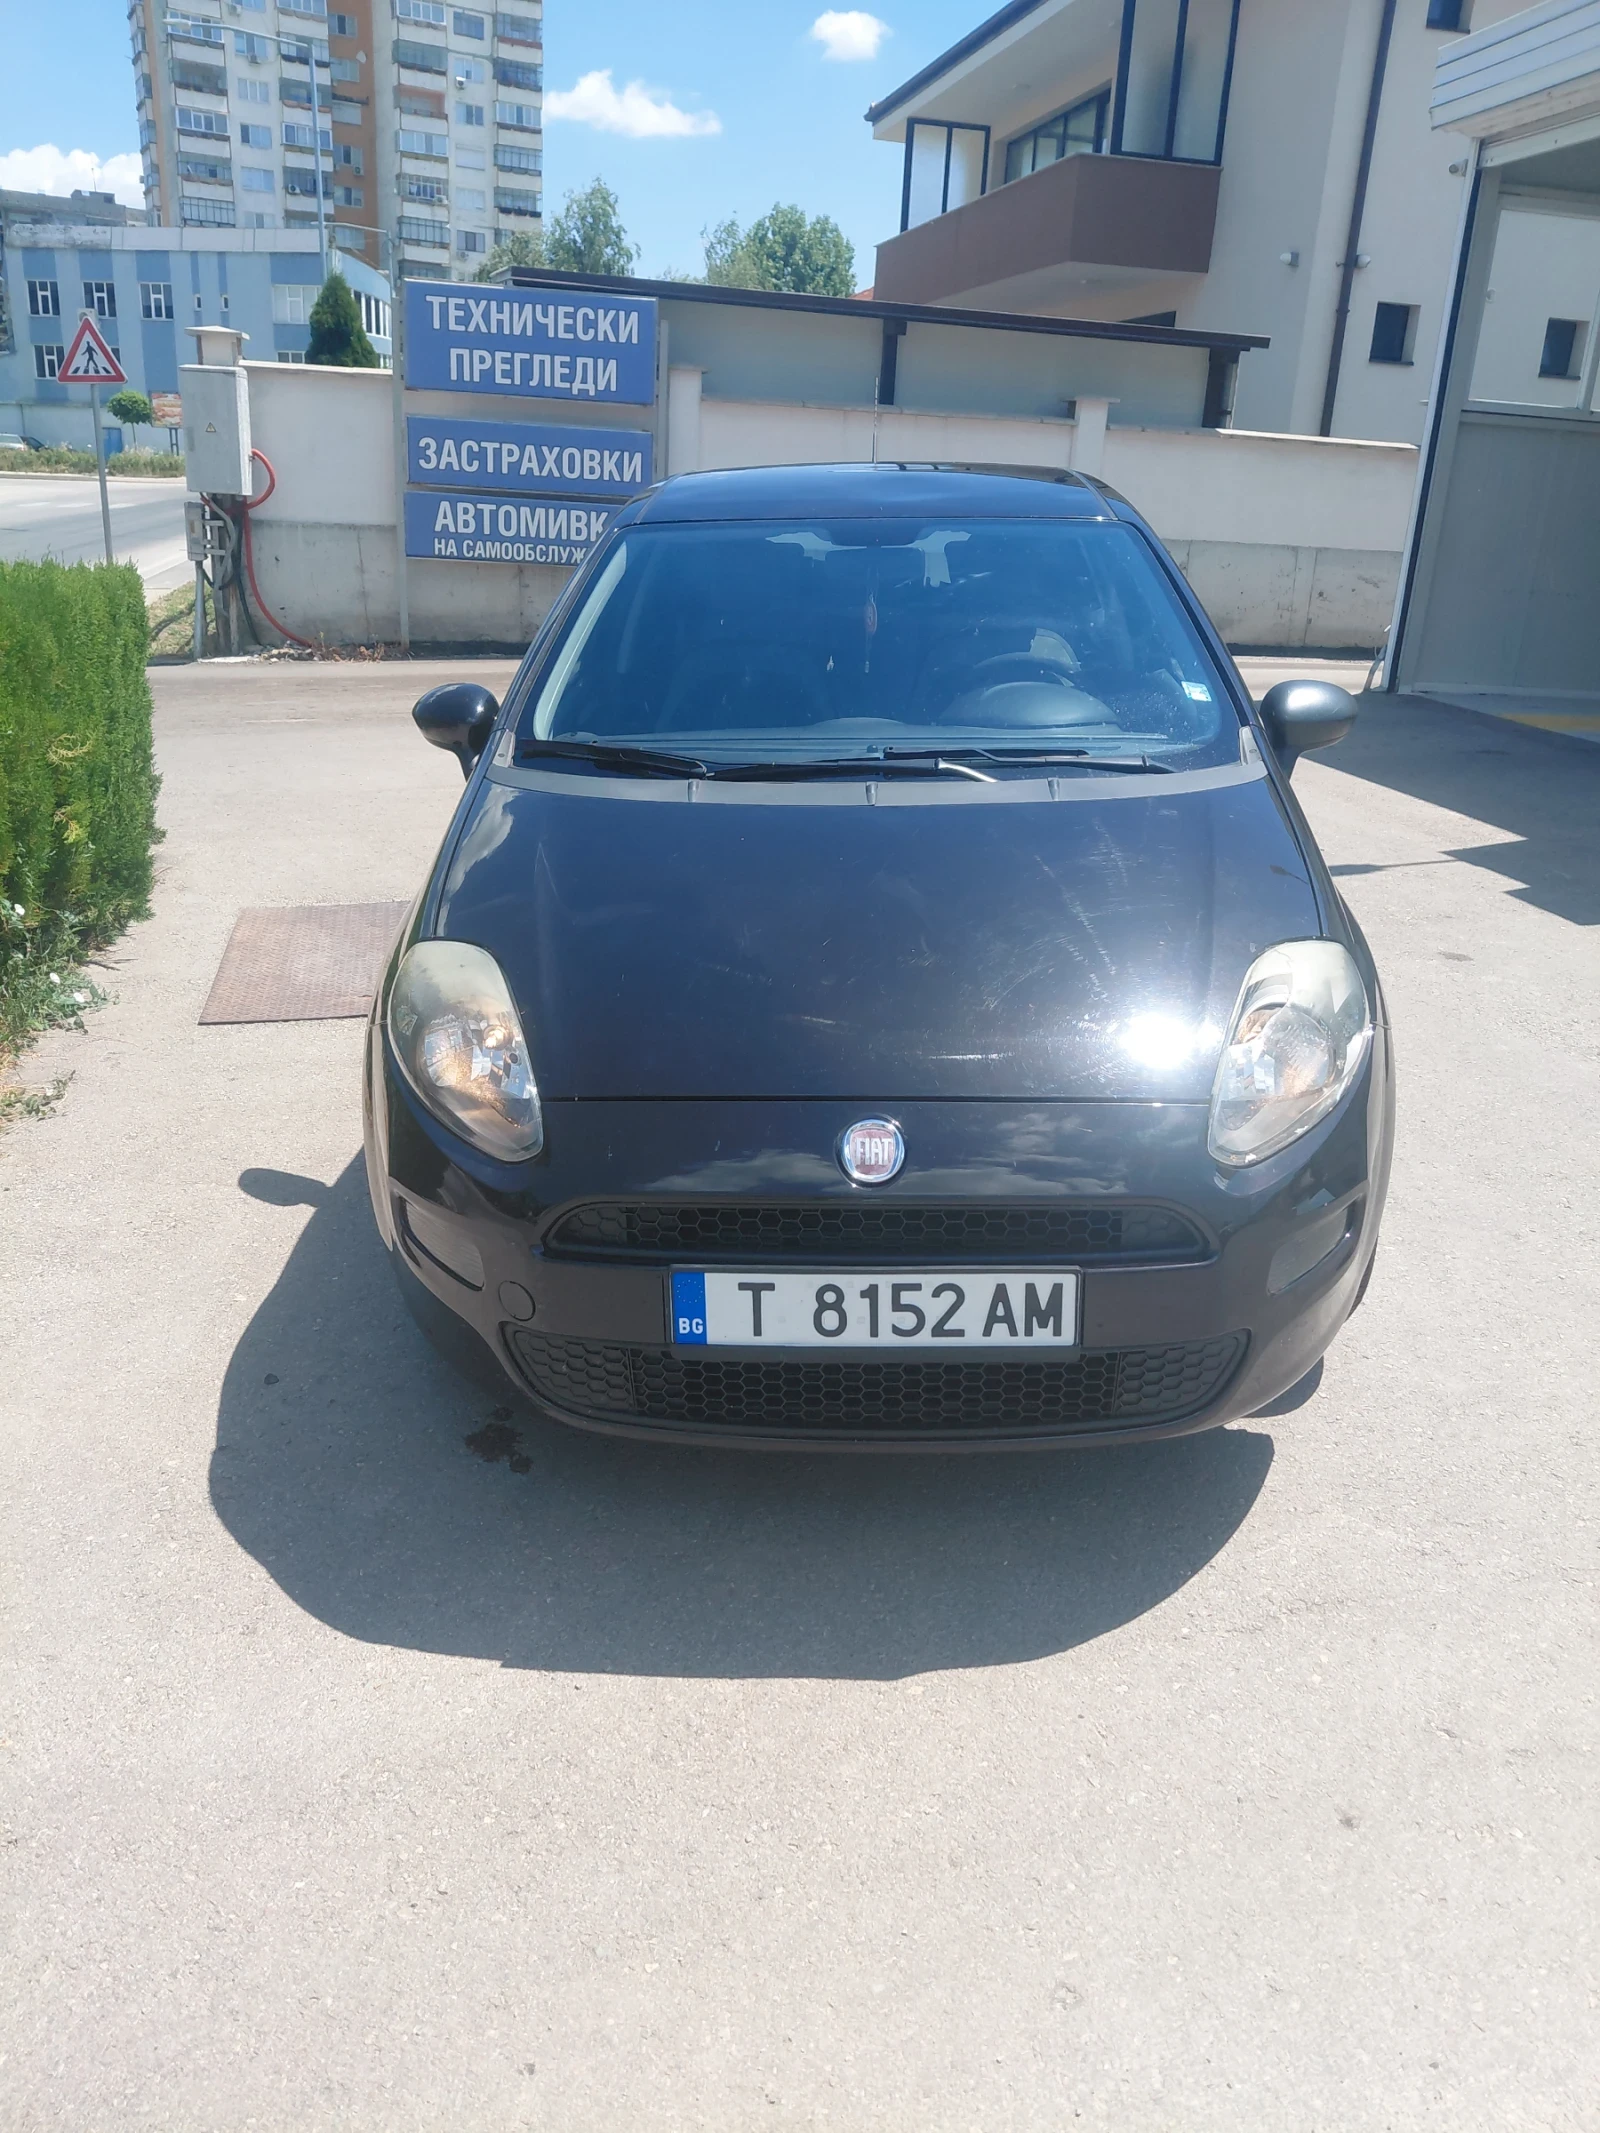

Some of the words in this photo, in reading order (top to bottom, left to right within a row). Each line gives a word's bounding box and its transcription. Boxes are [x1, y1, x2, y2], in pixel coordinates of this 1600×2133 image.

[426, 295, 639, 344] ТЕХНИЧЕСКИ
[449, 348, 617, 396] ПРЕГЛЕДИ
[418, 437, 642, 483] ЗАСТРАХОВКИ
[434, 538, 458, 556] НА
[855, 1137, 894, 1166] FIAT
[678, 1317, 704, 1334] BG
[737, 1282, 776, 1337] T
[812, 1283, 966, 1338] 8152
[982, 1282, 1064, 1338] AM
